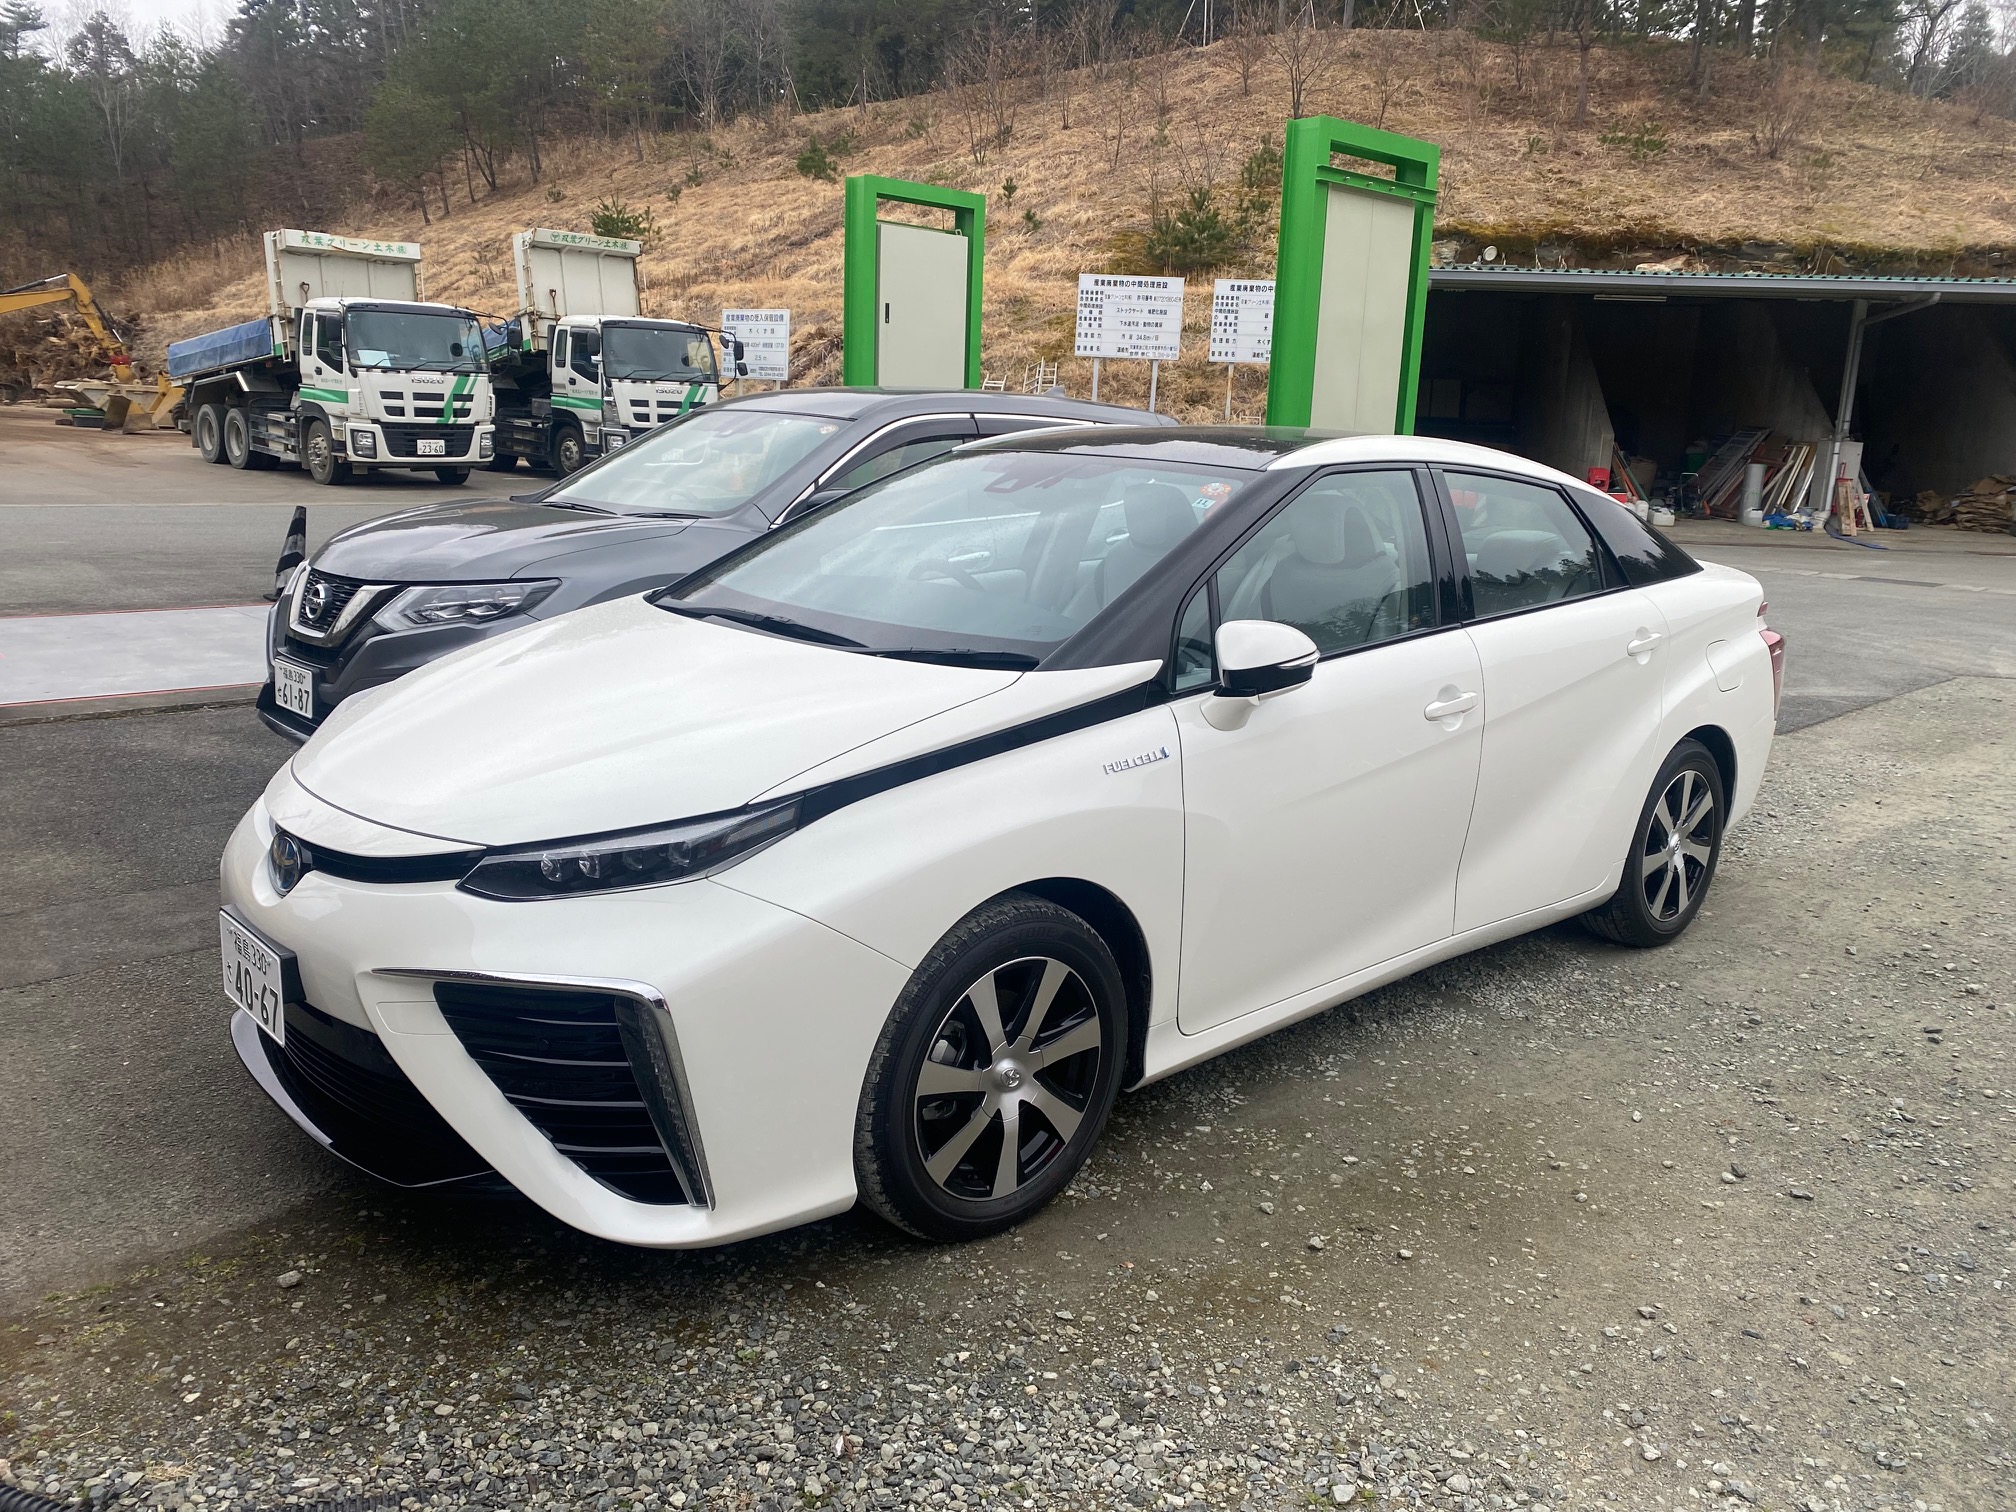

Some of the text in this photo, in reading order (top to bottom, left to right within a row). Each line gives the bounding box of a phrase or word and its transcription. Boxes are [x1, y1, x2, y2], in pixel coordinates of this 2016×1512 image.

[1093, 278, 1168, 289] 産業廃棄物の中間処理施設
[411, 376, 445, 384] ISUZU
[655, 386, 683, 395] ISUZU
[283, 682, 310, 714] 61-87
[235, 959, 279, 1034] 40-67
